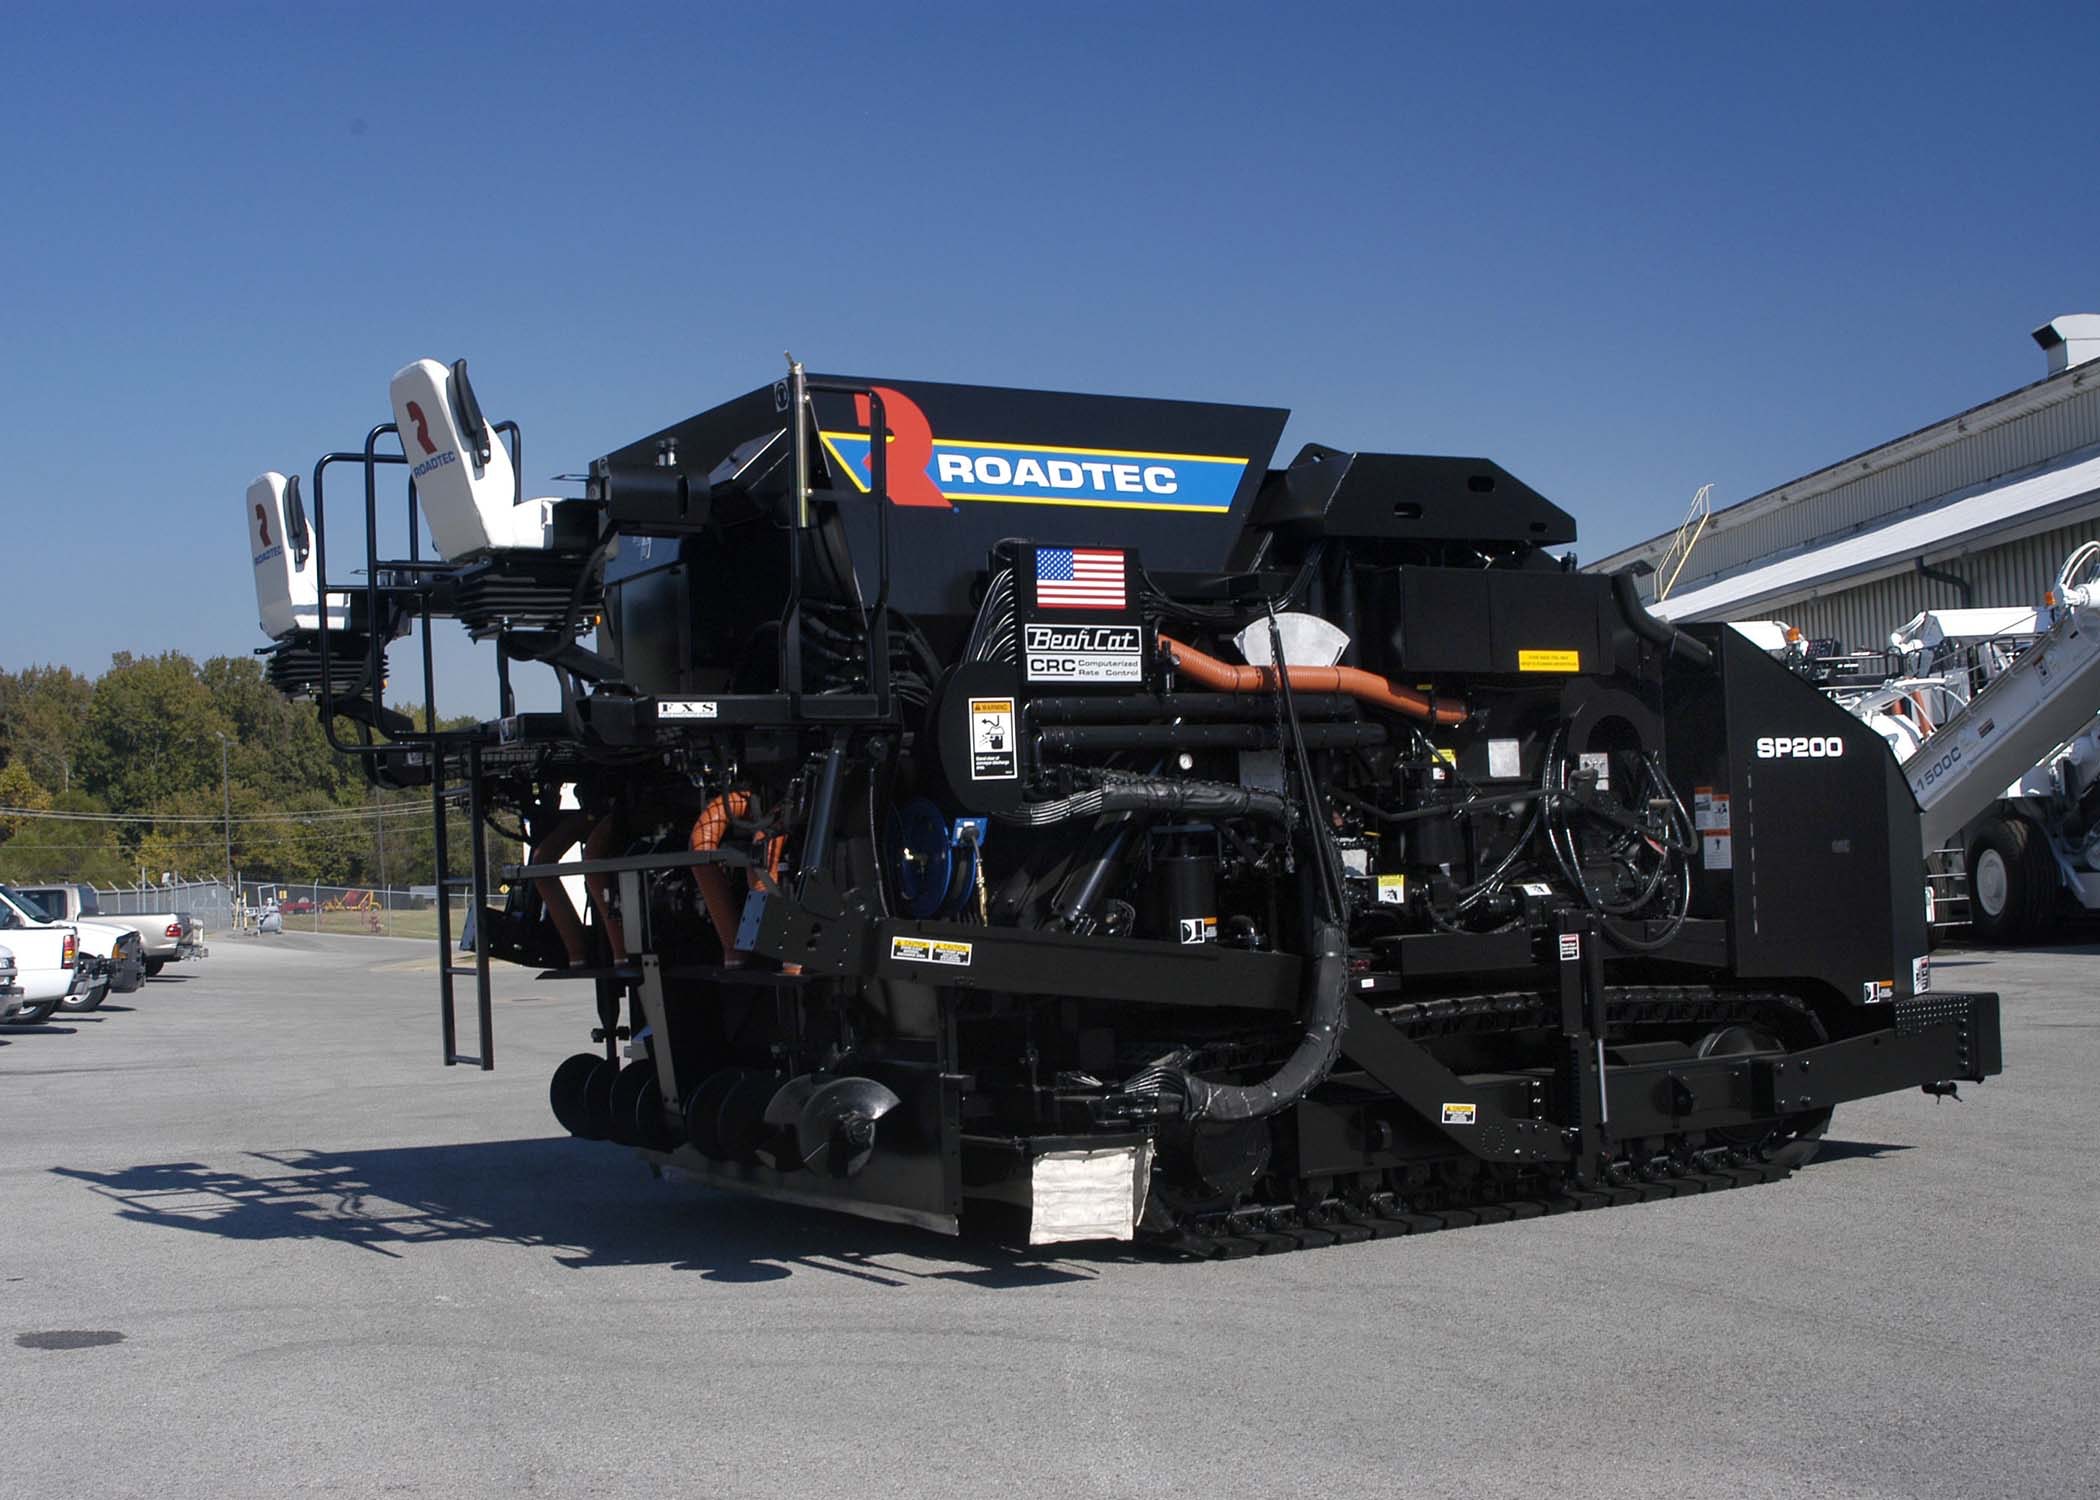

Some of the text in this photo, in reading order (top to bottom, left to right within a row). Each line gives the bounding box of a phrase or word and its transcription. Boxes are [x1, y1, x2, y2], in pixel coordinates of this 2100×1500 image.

[413, 451, 456, 478] ROADTEC
[937, 453, 1178, 494] ROADTEC
[1031, 658, 1076, 673] CRC
[1078, 659, 1138, 668] Computerized
[1105, 669, 1139, 677] Control
[1757, 736, 1843, 758] SP200
